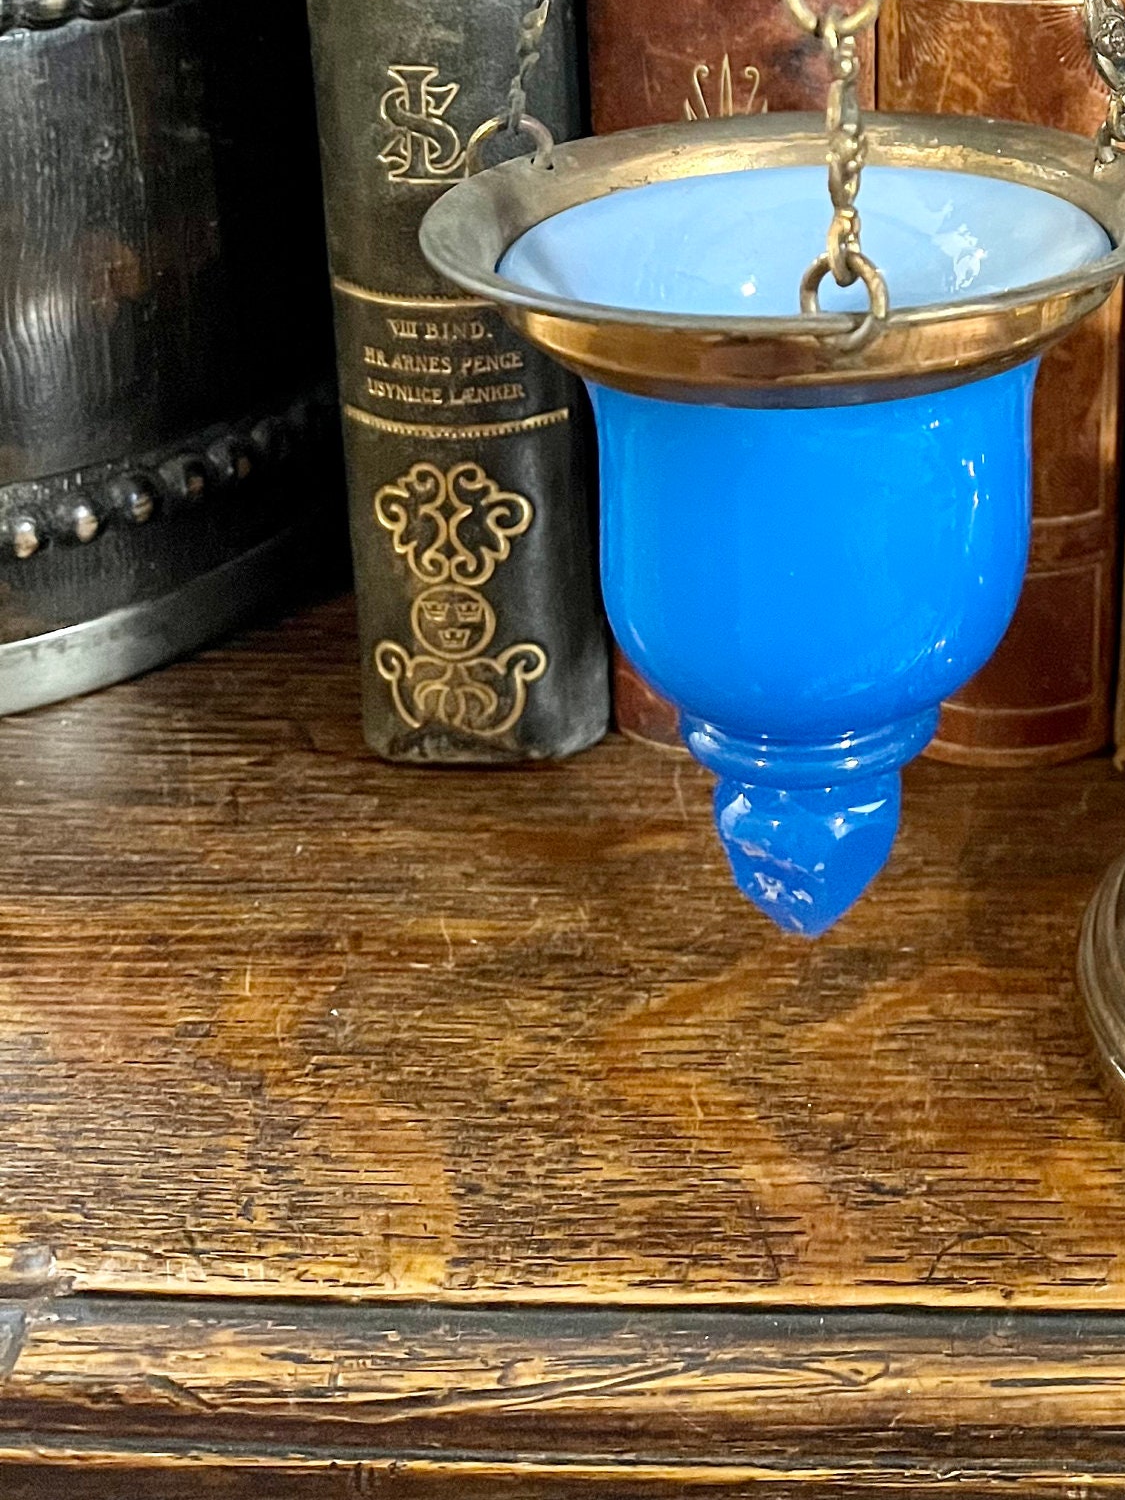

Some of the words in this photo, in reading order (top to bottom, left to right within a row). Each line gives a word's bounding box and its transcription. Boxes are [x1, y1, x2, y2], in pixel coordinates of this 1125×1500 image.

[387, 319, 418, 339] VIII
[391, 353, 452, 375] ARNES
[461, 352, 524, 376] PENGE
